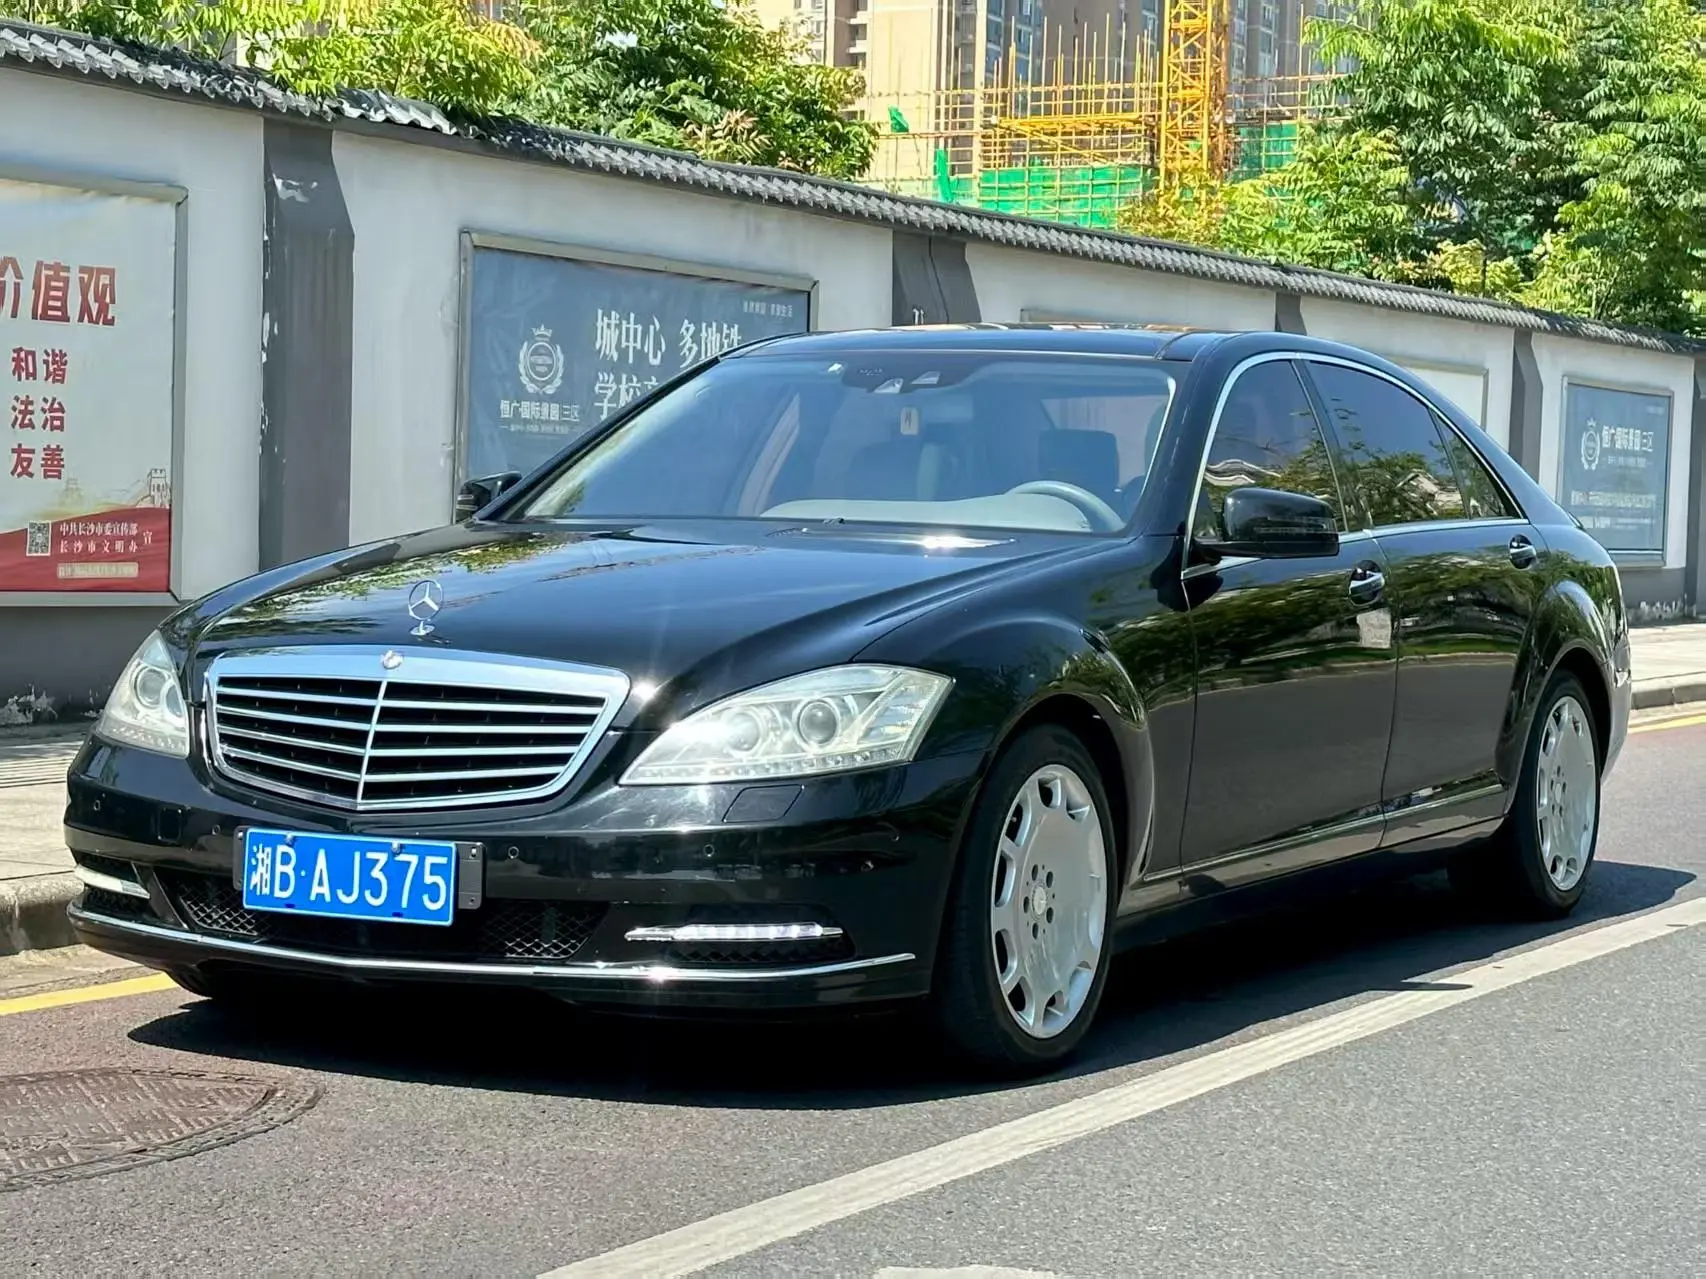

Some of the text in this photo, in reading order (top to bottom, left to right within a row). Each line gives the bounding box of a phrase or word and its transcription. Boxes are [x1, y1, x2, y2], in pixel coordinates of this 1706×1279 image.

[0, 256, 116, 326] 价值观
[595, 309, 666, 366] 城中心
[11, 347, 68, 385] 和谐
[11, 395, 66, 432] 法治
[10, 444, 65, 480] 友善
[59, 521, 139, 536] 中共长沙市委宣传部
[59, 540, 138, 554] 长沙市文明办
[250, 843, 449, 911] 湘B·AJ375
